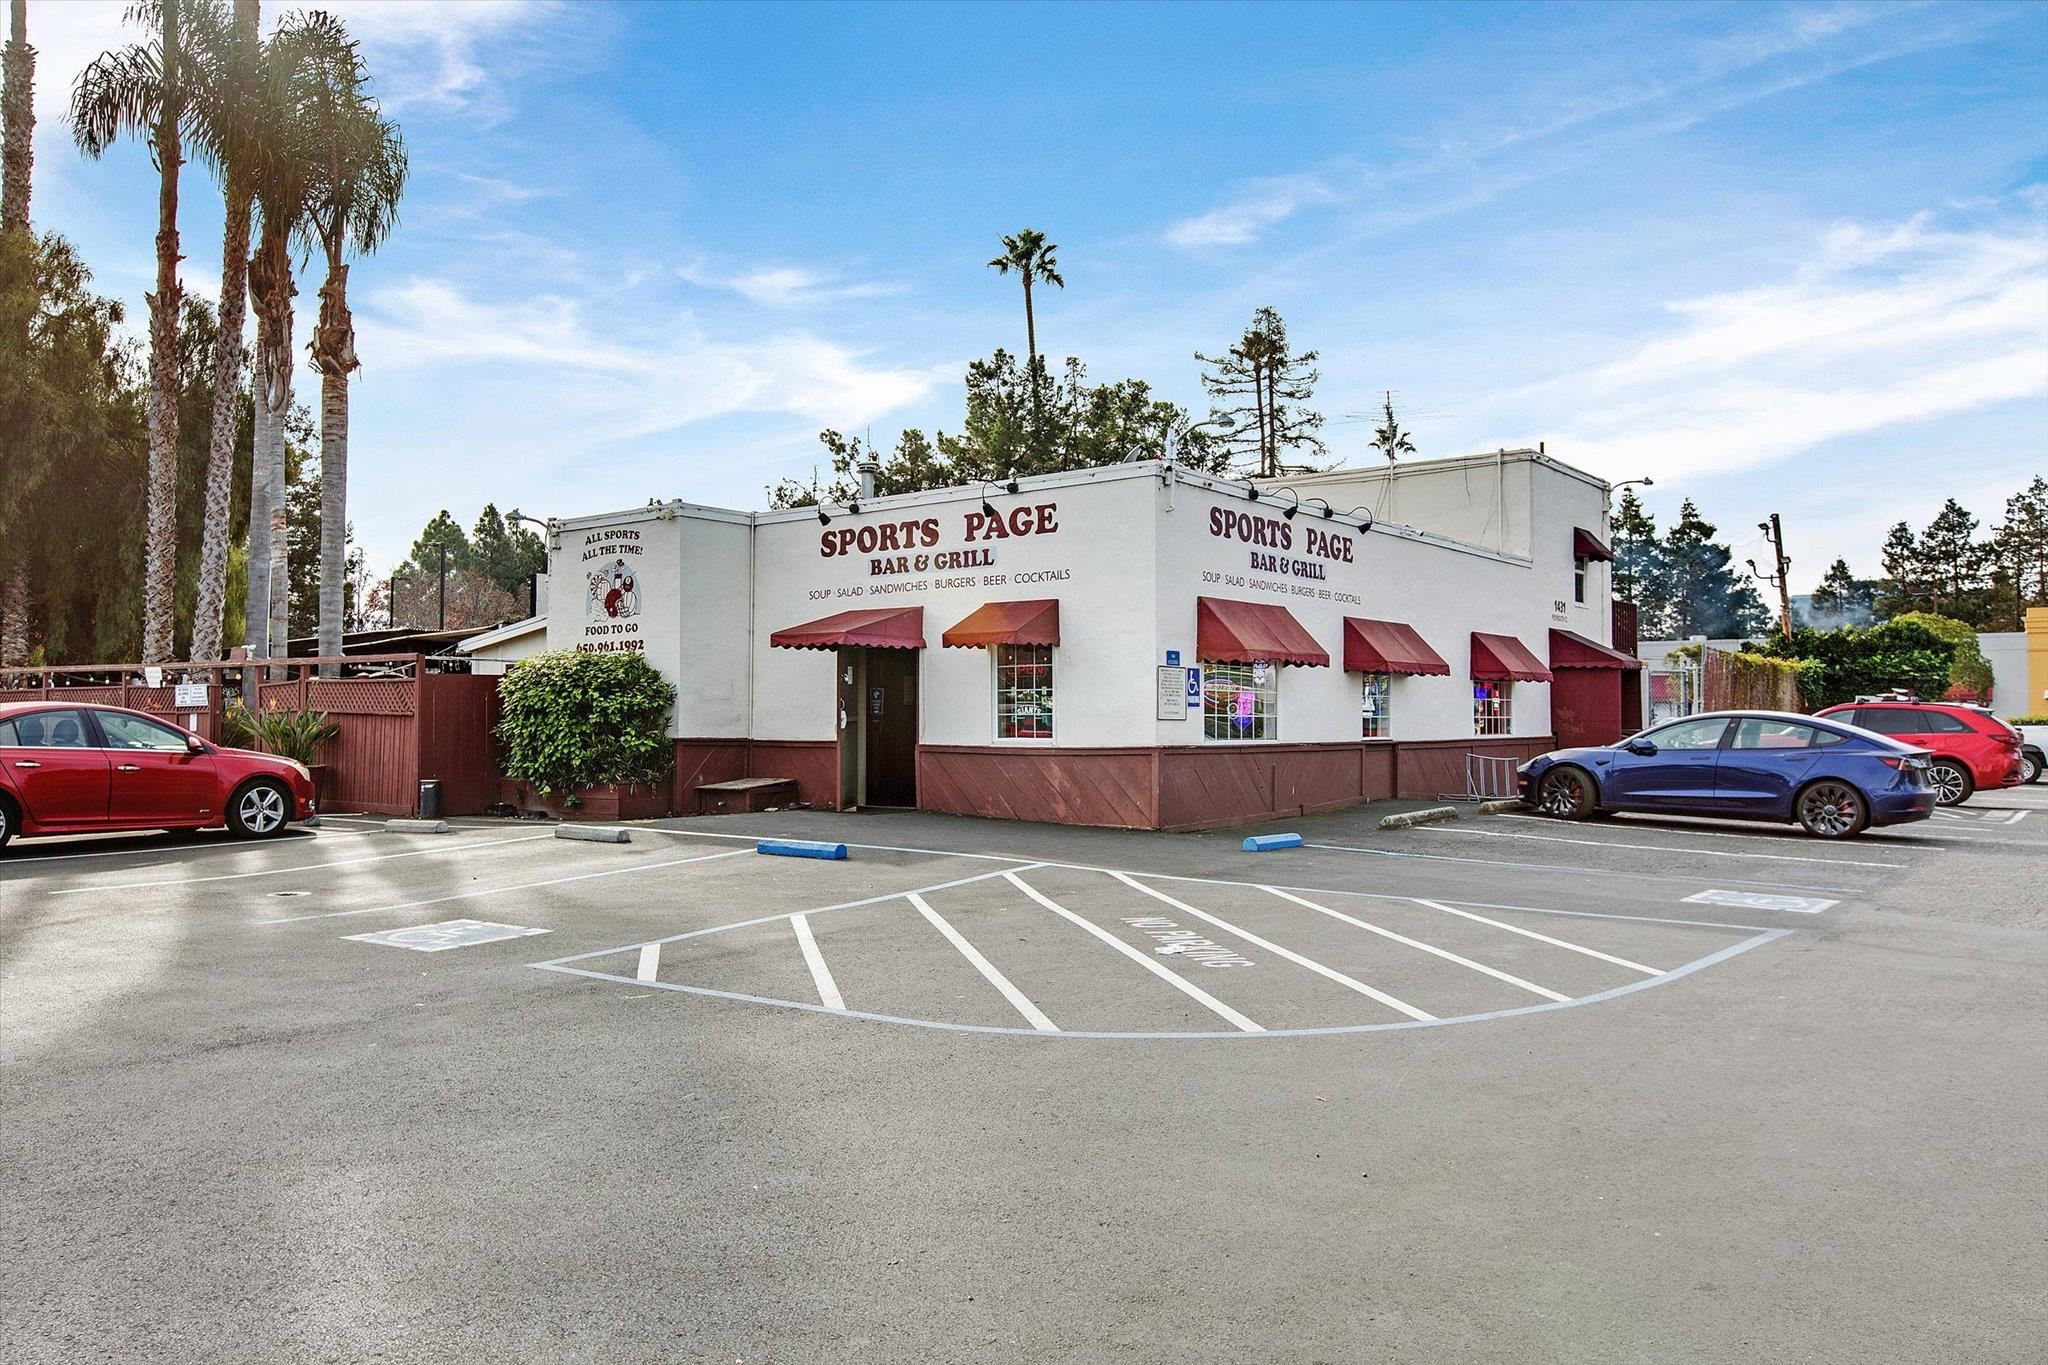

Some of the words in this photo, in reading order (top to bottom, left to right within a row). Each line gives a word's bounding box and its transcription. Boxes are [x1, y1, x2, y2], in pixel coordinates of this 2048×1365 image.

[585, 533, 602, 545] ALL
[604, 530, 639, 540] SPORTS
[820, 519, 939, 556] SPORTS
[964, 503, 1059, 542] PAGE
[1210, 507, 1291, 549] SPORTS
[1306, 527, 1354, 563] PAGE
[582, 550, 597, 561] ALL
[600, 546, 616, 555] THE
[619, 545, 642, 555] TIME!
[870, 556, 910, 576] BAR
[914, 554, 929, 572] &
[933, 549, 995, 570] GRILL
[1250, 551, 1278, 573] BAR
[1279, 557, 1290, 575] &
[1292, 559, 1326, 581] GRILL
[808, 588, 832, 601] SOUP
[837, 586, 864, 598] SALAD
[869, 580, 928, 595] SANDWICHES
[934, 576, 976, 590] BURGERS
[983, 574, 1008, 586] BEER
[1014, 569, 1071, 584] COCKTAILS
[1202, 570, 1221, 584] SOUP
[1224, 574, 1245, 588] SALAD
[1249, 578, 1288, 594] SANDWICHES
[1291, 585, 1316, 598] BURGERS
[1318, 589, 1332, 600] BEER
[1334, 592, 1361, 605] COCKTAILS
[585, 626, 608, 635] FOOD
[611, 625, 622, 634] TO
[625, 624, 638, 632] GO
[577, 640, 643, 652] 650.961.1992
